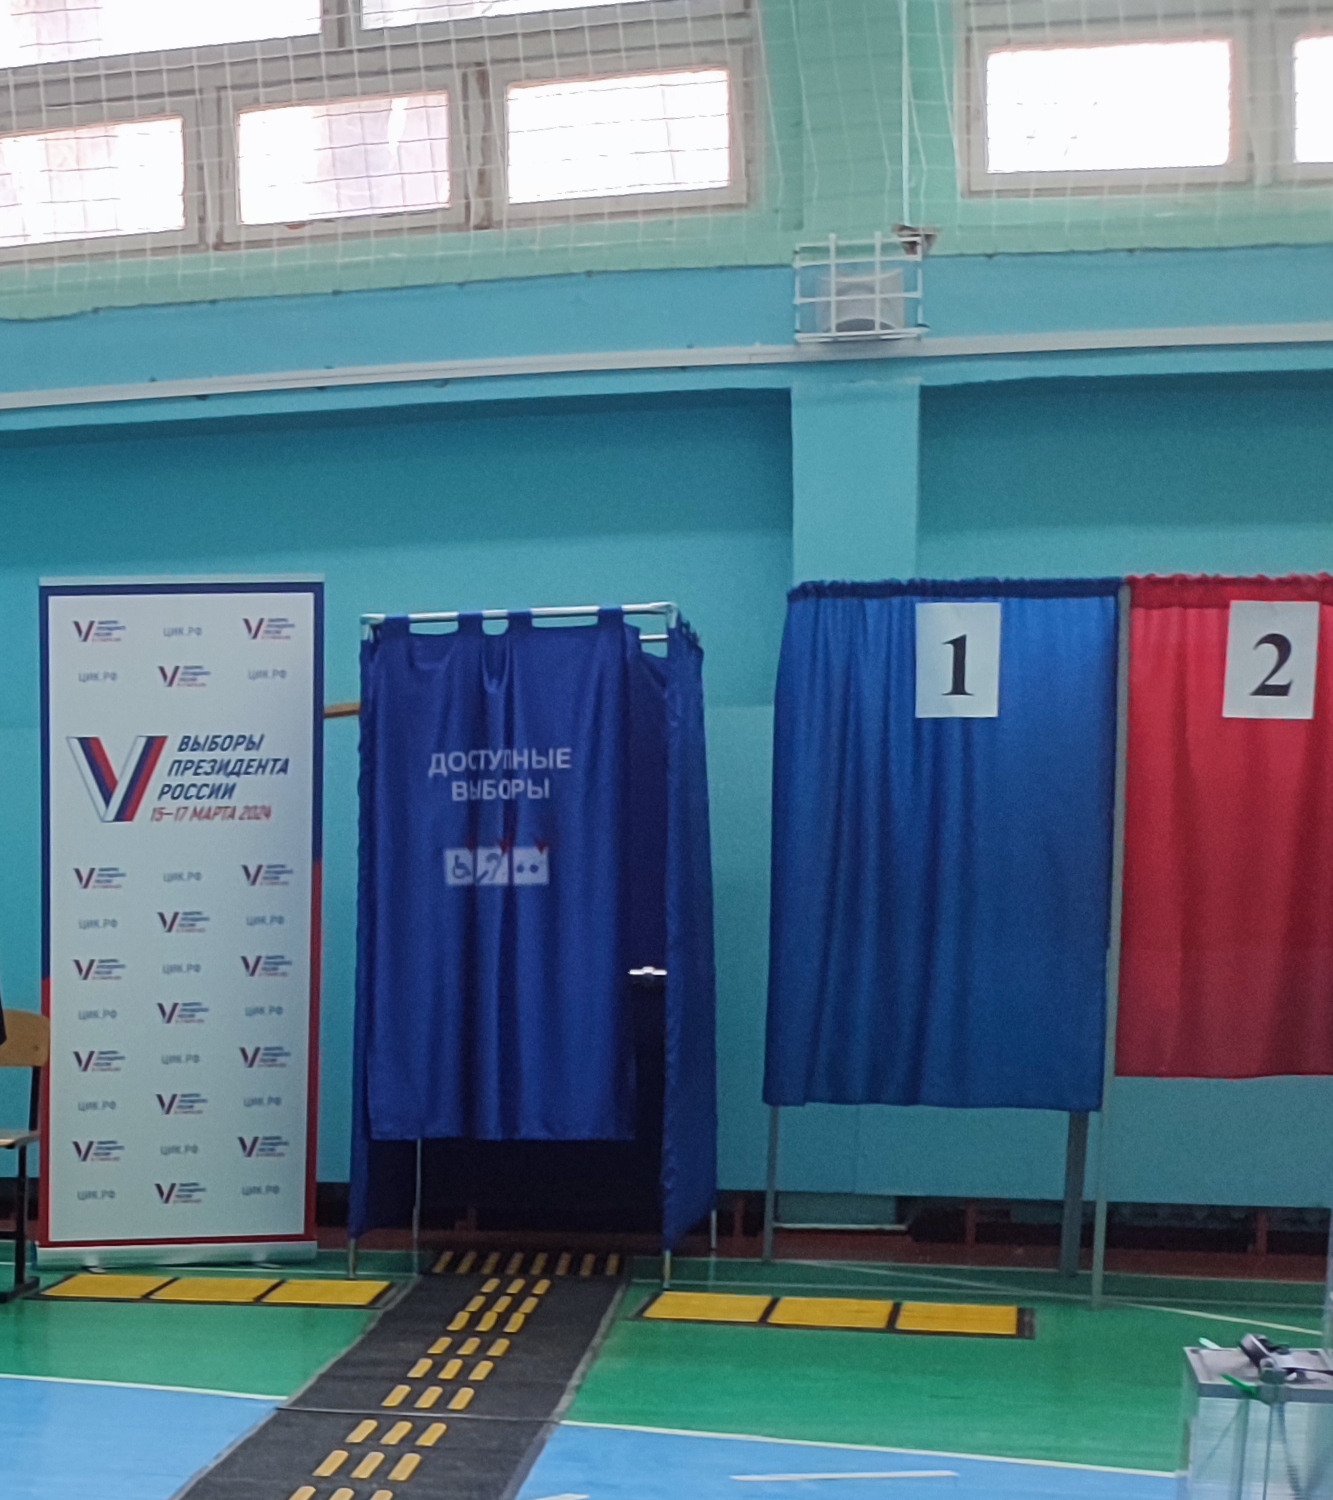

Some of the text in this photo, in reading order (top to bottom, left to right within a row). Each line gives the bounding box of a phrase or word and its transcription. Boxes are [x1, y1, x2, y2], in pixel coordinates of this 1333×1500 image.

[941, 634, 974, 696] 1
[1249, 633, 1294, 696] 2
[177, 733, 265, 752] ВЫБОРЫ
[167, 758, 290, 778] ПРЕЗИДЕНТА
[428, 747, 572, 778] ДОСТУПНЫЕ
[157, 782, 237, 801] РОССИИ
[451, 778, 550, 800] ВЫБОРЫ
[189, 805, 237, 821] МАРТА
[238, 804, 272, 821] 2024
